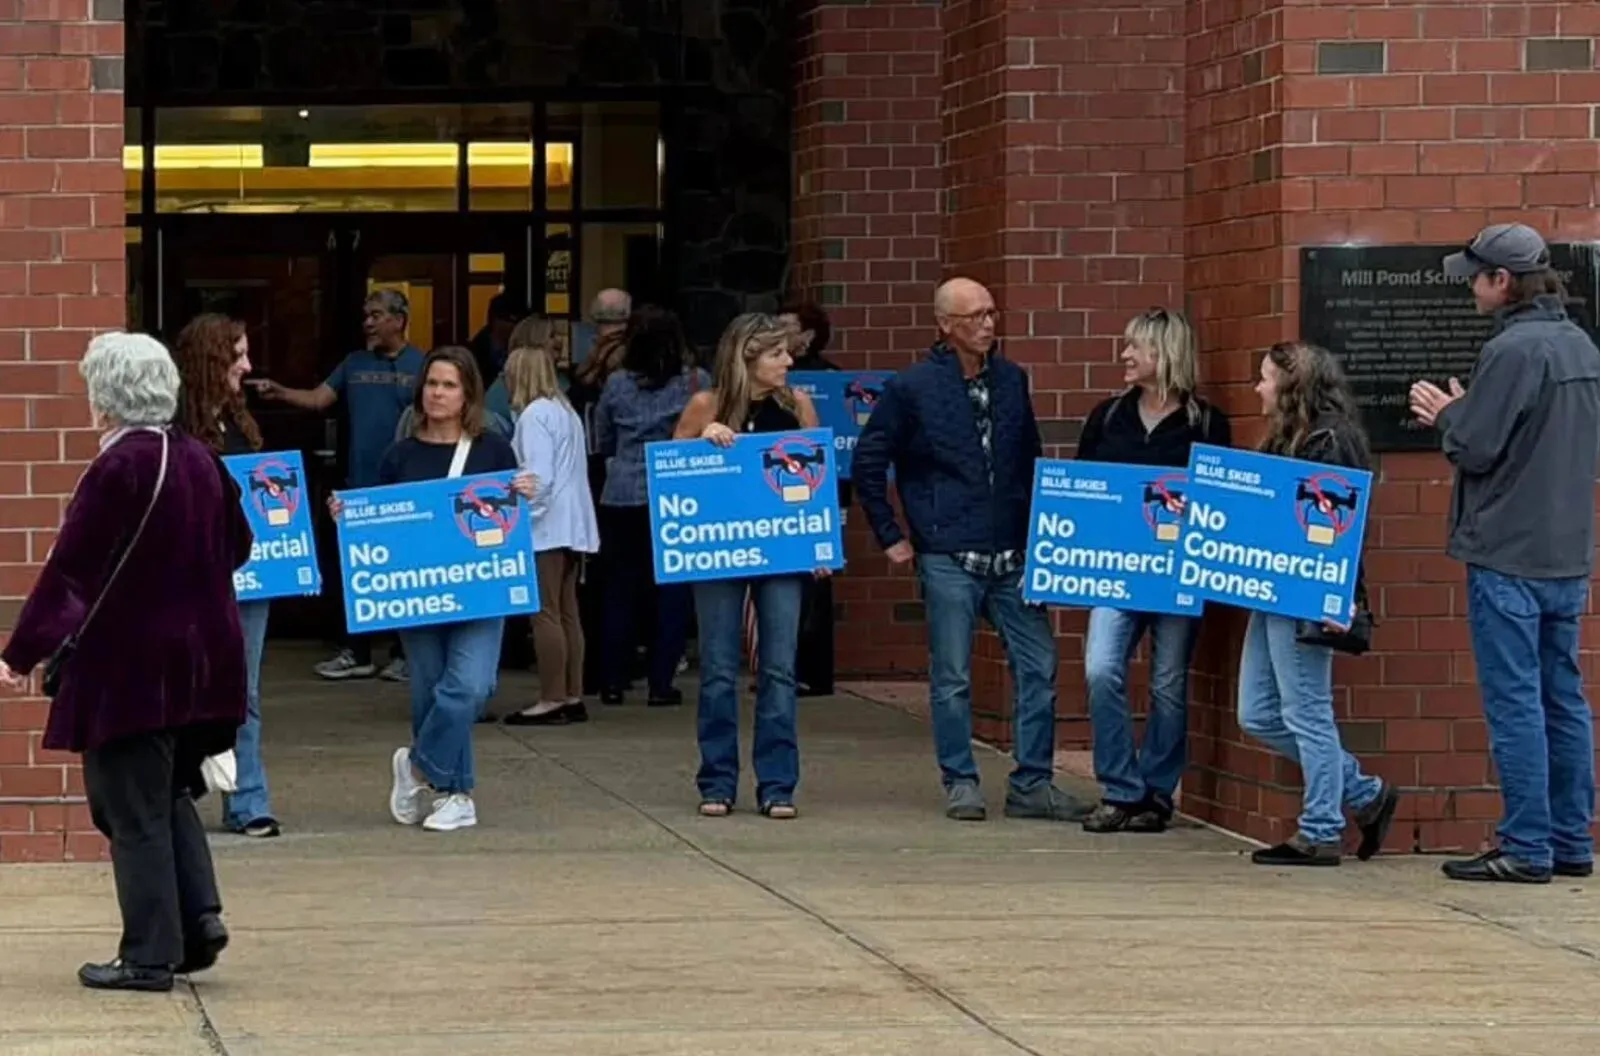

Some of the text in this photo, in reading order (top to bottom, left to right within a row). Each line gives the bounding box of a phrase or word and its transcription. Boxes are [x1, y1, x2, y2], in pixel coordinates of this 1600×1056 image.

[1341, 268, 1373, 286] Mill
[1376, 268, 1421, 286] Pond
[655, 454, 724, 470] BLUE SKIES
[1195, 462, 1262, 485] BLUE SKIES
[1041, 476, 1108, 492] BLUE SKIES
[344, 504, 378, 520] BLUE
[379, 500, 416, 516] SKIES
[659, 494, 698, 518] No
[1189, 501, 1226, 531] No
[660, 508, 831, 545] Commercial
[1037, 512, 1075, 538] No
[250, 529, 310, 561] ercial
[349, 543, 389, 567] No
[1034, 541, 1174, 575] Commerci
[1184, 532, 1348, 585] Commercial
[351, 550, 526, 594] Commercial
[663, 547, 768, 573] Drones.
[1032, 567, 1130, 600] Drones.
[1180, 559, 1278, 603] Drones.
[355, 593, 462, 623] Drones.
